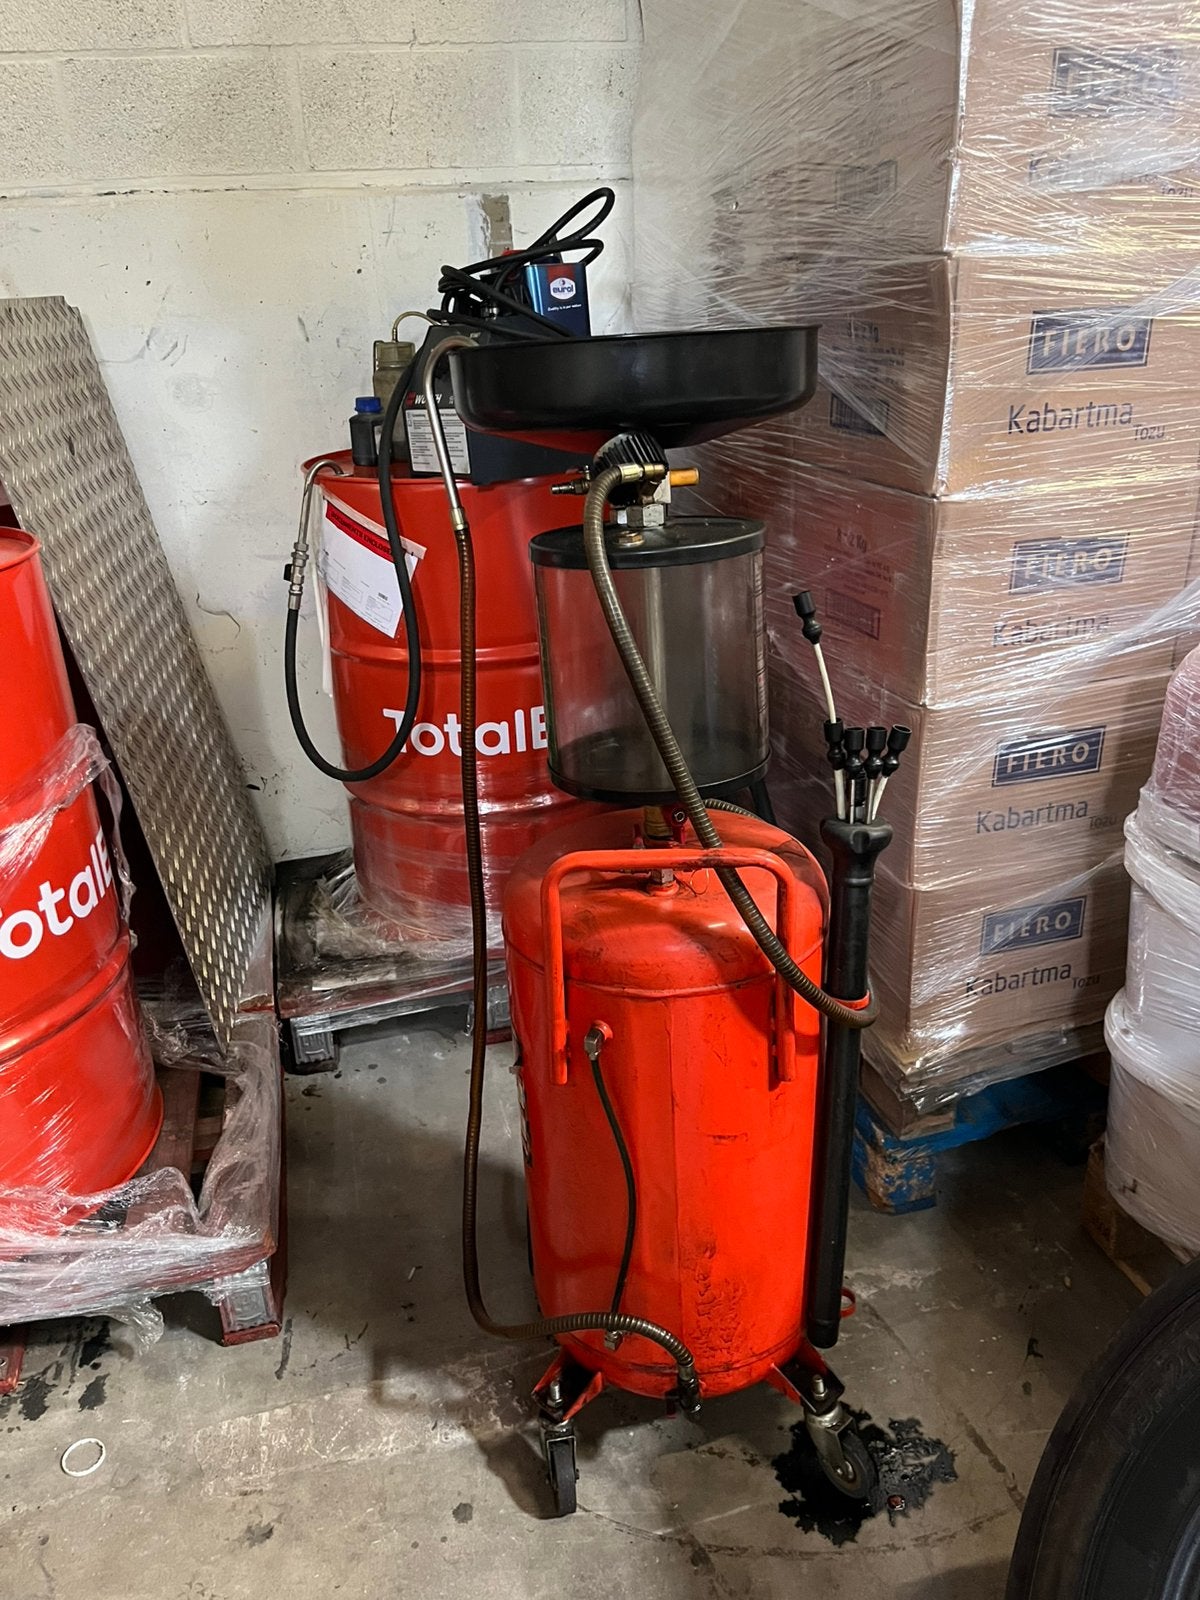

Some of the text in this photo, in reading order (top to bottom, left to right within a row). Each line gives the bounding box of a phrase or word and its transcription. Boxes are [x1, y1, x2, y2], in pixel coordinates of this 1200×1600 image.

[552, 284, 574, 293] eurol
[1043, 324, 1136, 357] FIERO
[1008, 401, 1165, 440] Kabartma Tozu
[1024, 548, 1114, 579] FIERO
[1007, 741, 1089, 774] FIERO
[976, 801, 1089, 834] Kabartma
[0, 824, 112, 959] otalE
[993, 911, 1072, 942] FIERO
[965, 963, 1101, 998] Kabartma Tozu
